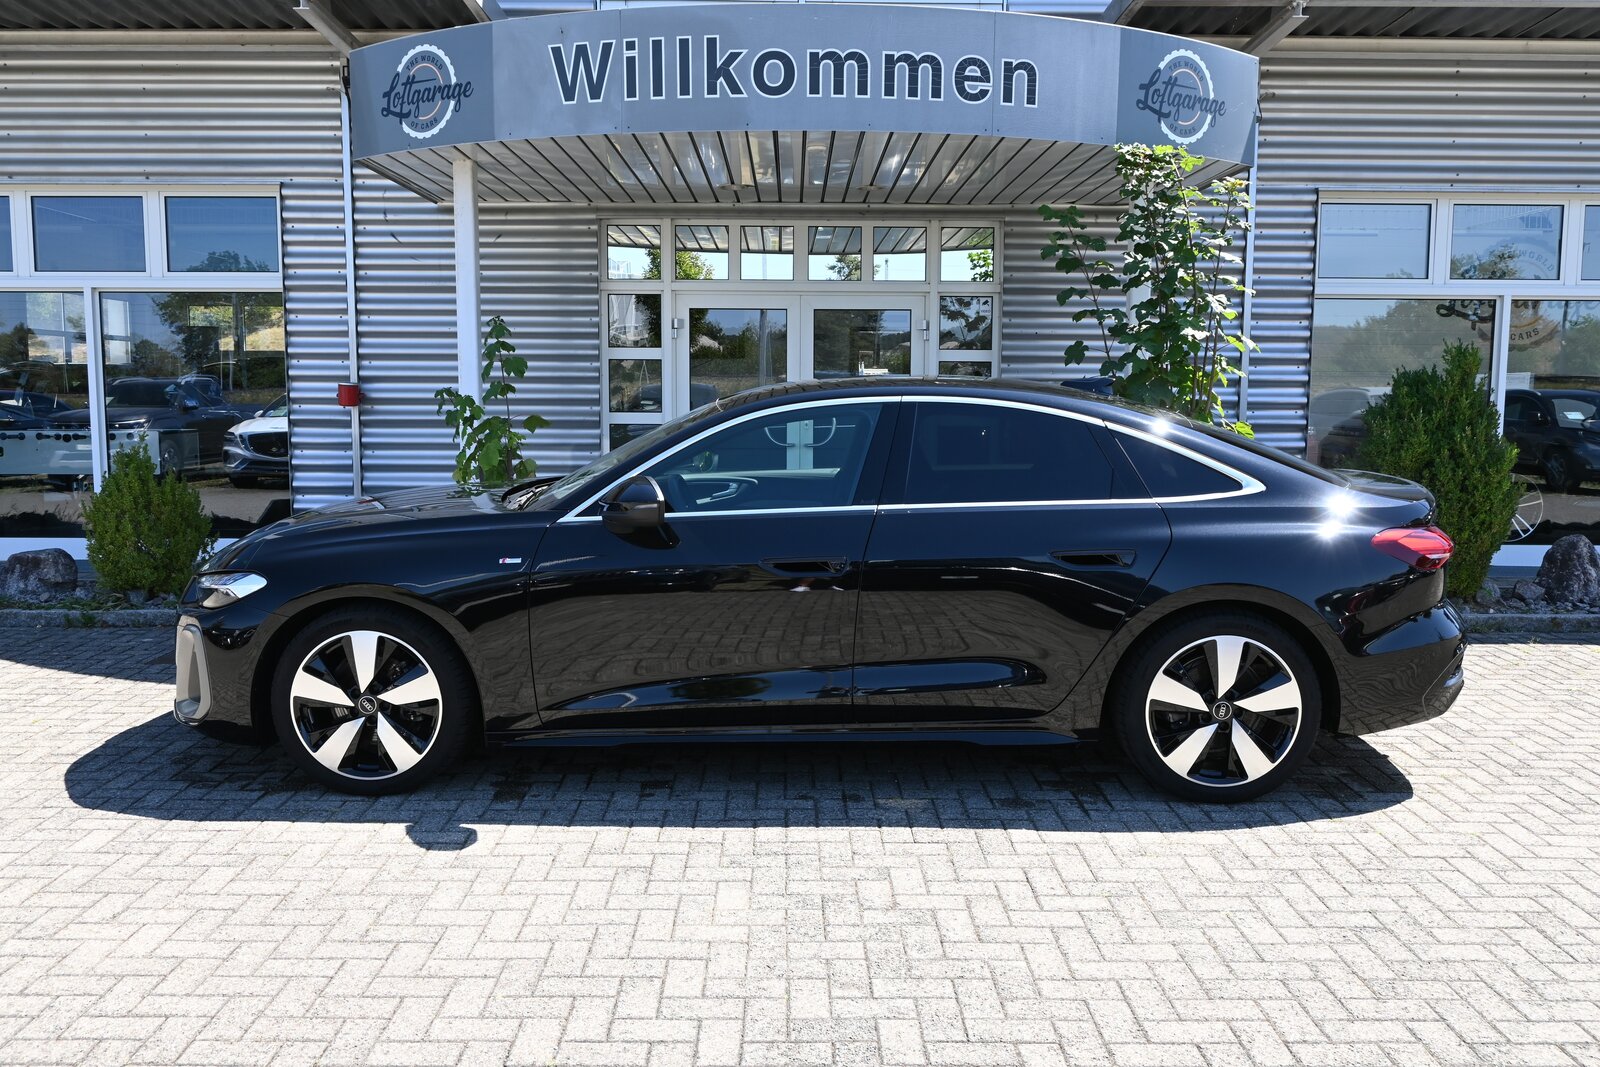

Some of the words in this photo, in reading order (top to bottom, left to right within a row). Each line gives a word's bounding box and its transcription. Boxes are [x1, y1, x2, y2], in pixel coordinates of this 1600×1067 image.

[406, 57, 419, 71] THE
[420, 55, 444, 71] WORLD
[547, 35, 1039, 108] Willkommen
[1184, 60, 1204, 82] WORLD
[381, 72, 474, 125] Loftgarage
[1136, 68, 1227, 128] Loftgarage
[410, 120, 419, 129] OF
[420, 116, 438, 130] CARS
[1518, 249, 1555, 272] WORLD
[1510, 327, 1540, 341] CARS
